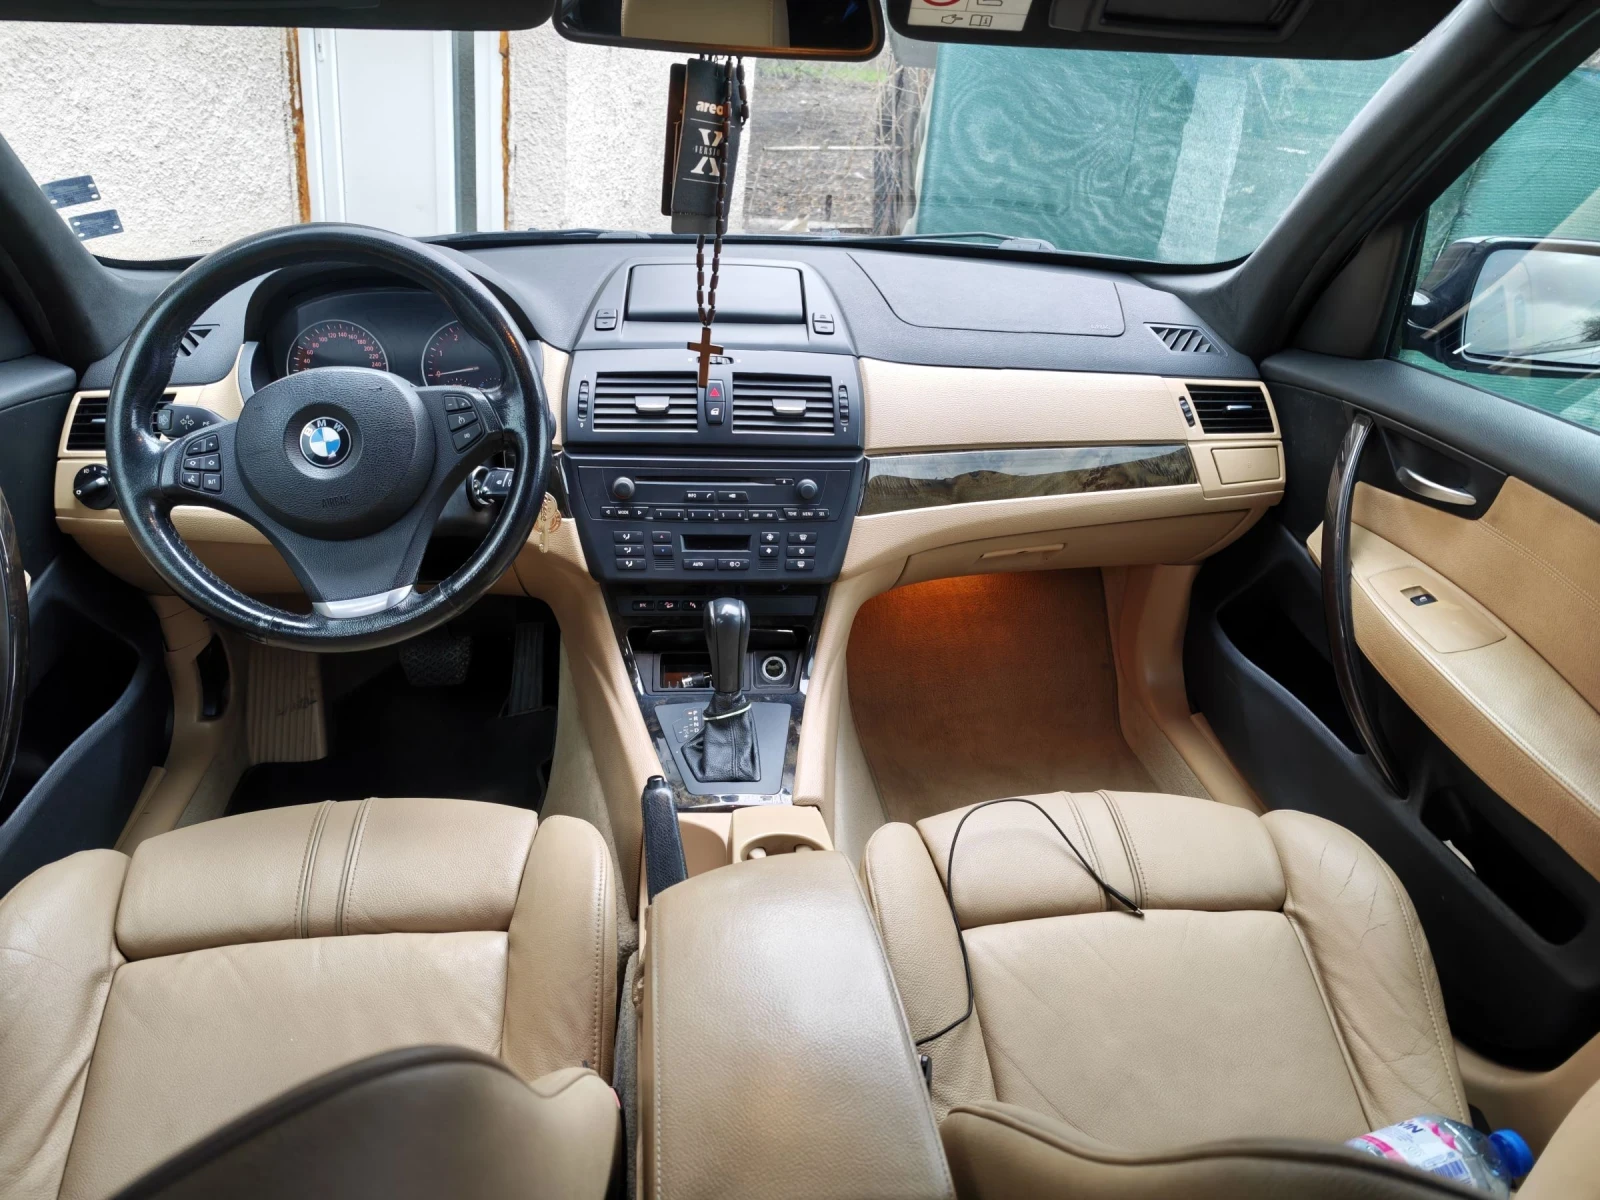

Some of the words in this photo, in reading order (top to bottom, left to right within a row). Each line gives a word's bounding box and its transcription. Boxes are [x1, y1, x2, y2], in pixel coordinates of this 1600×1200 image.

[695, 100, 732, 116] areo
[304, 419, 344, 437] BMW
[322, 495, 350, 508] AIRBAG
